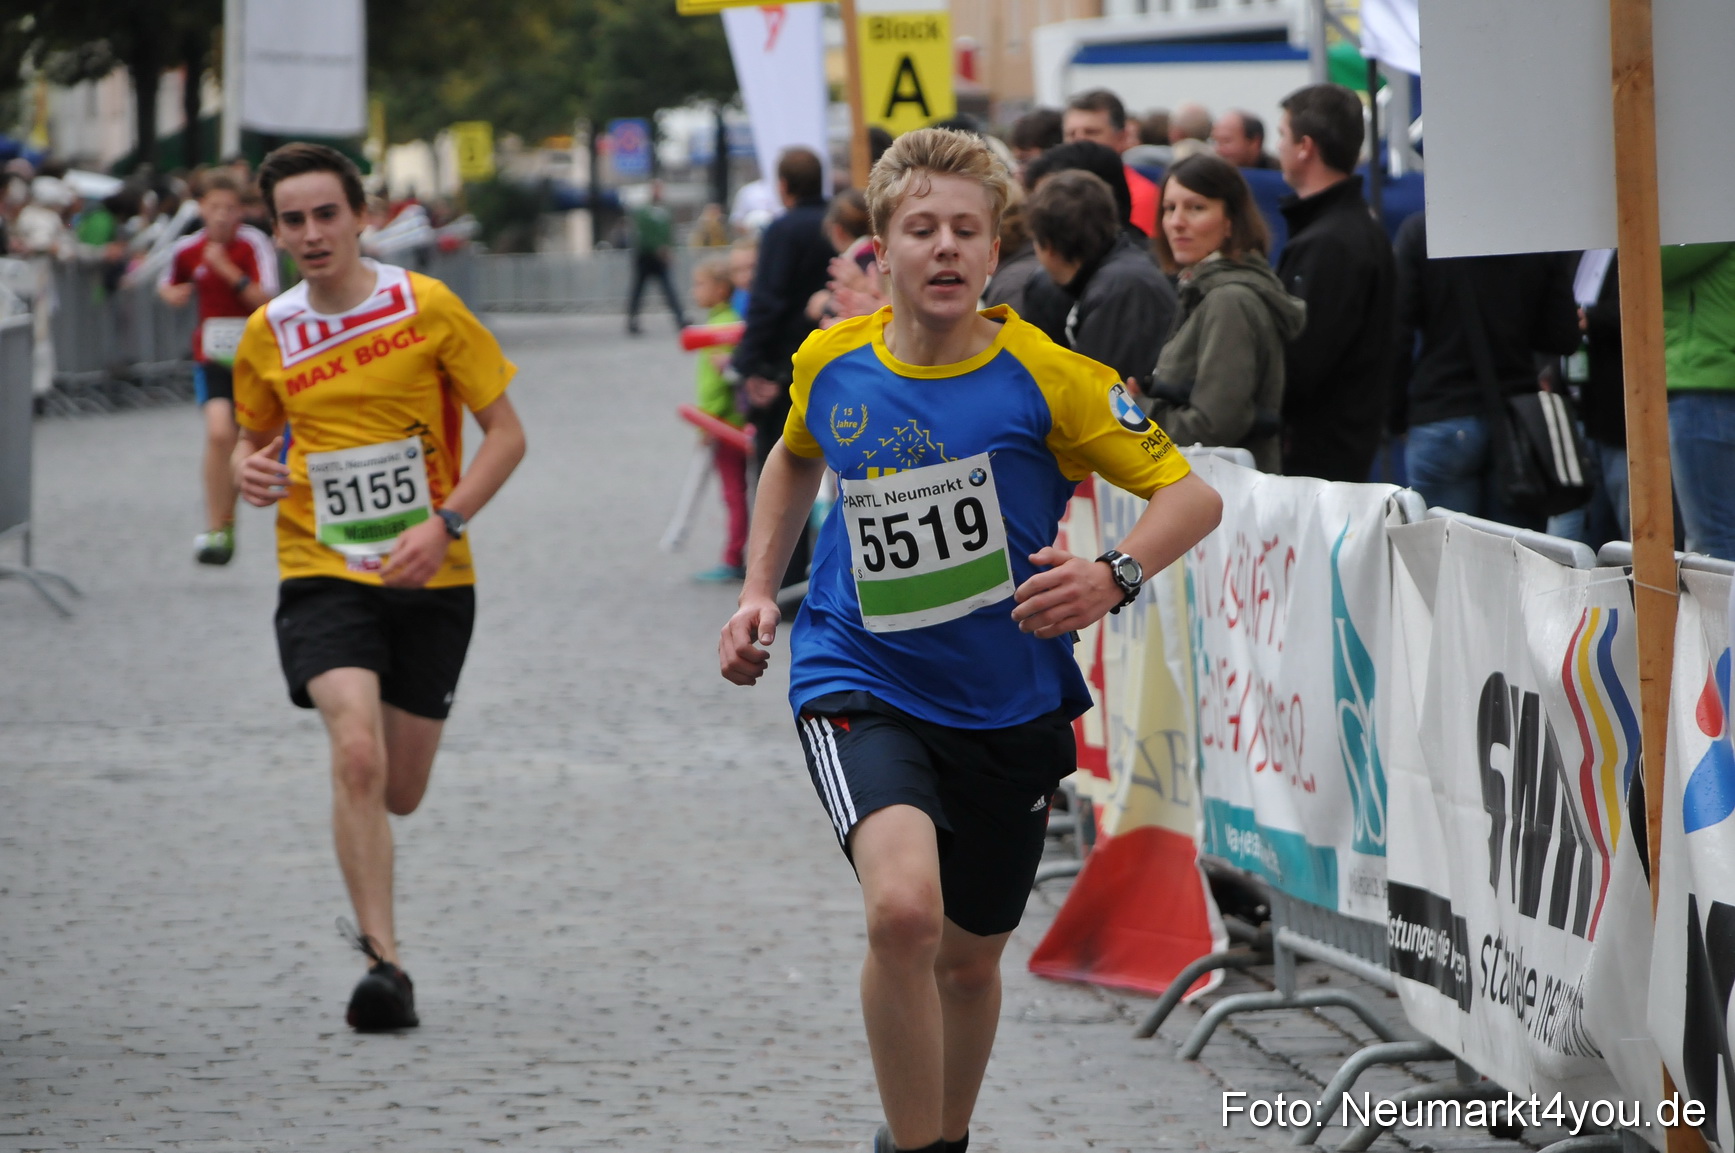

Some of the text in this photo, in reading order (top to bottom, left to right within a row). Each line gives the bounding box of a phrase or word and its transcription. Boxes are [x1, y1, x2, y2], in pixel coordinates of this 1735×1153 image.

[884, 55, 931, 118] A
[286, 326, 427, 397] MAX BÖGL
[836, 420, 858, 429] Jahre
[843, 407, 853, 416] 15
[1151, 440, 1174, 462] Neum
[324, 466, 416, 516] 5155
[843, 478, 964, 508] PARTL Neumarkt
[858, 496, 989, 573] 5519
